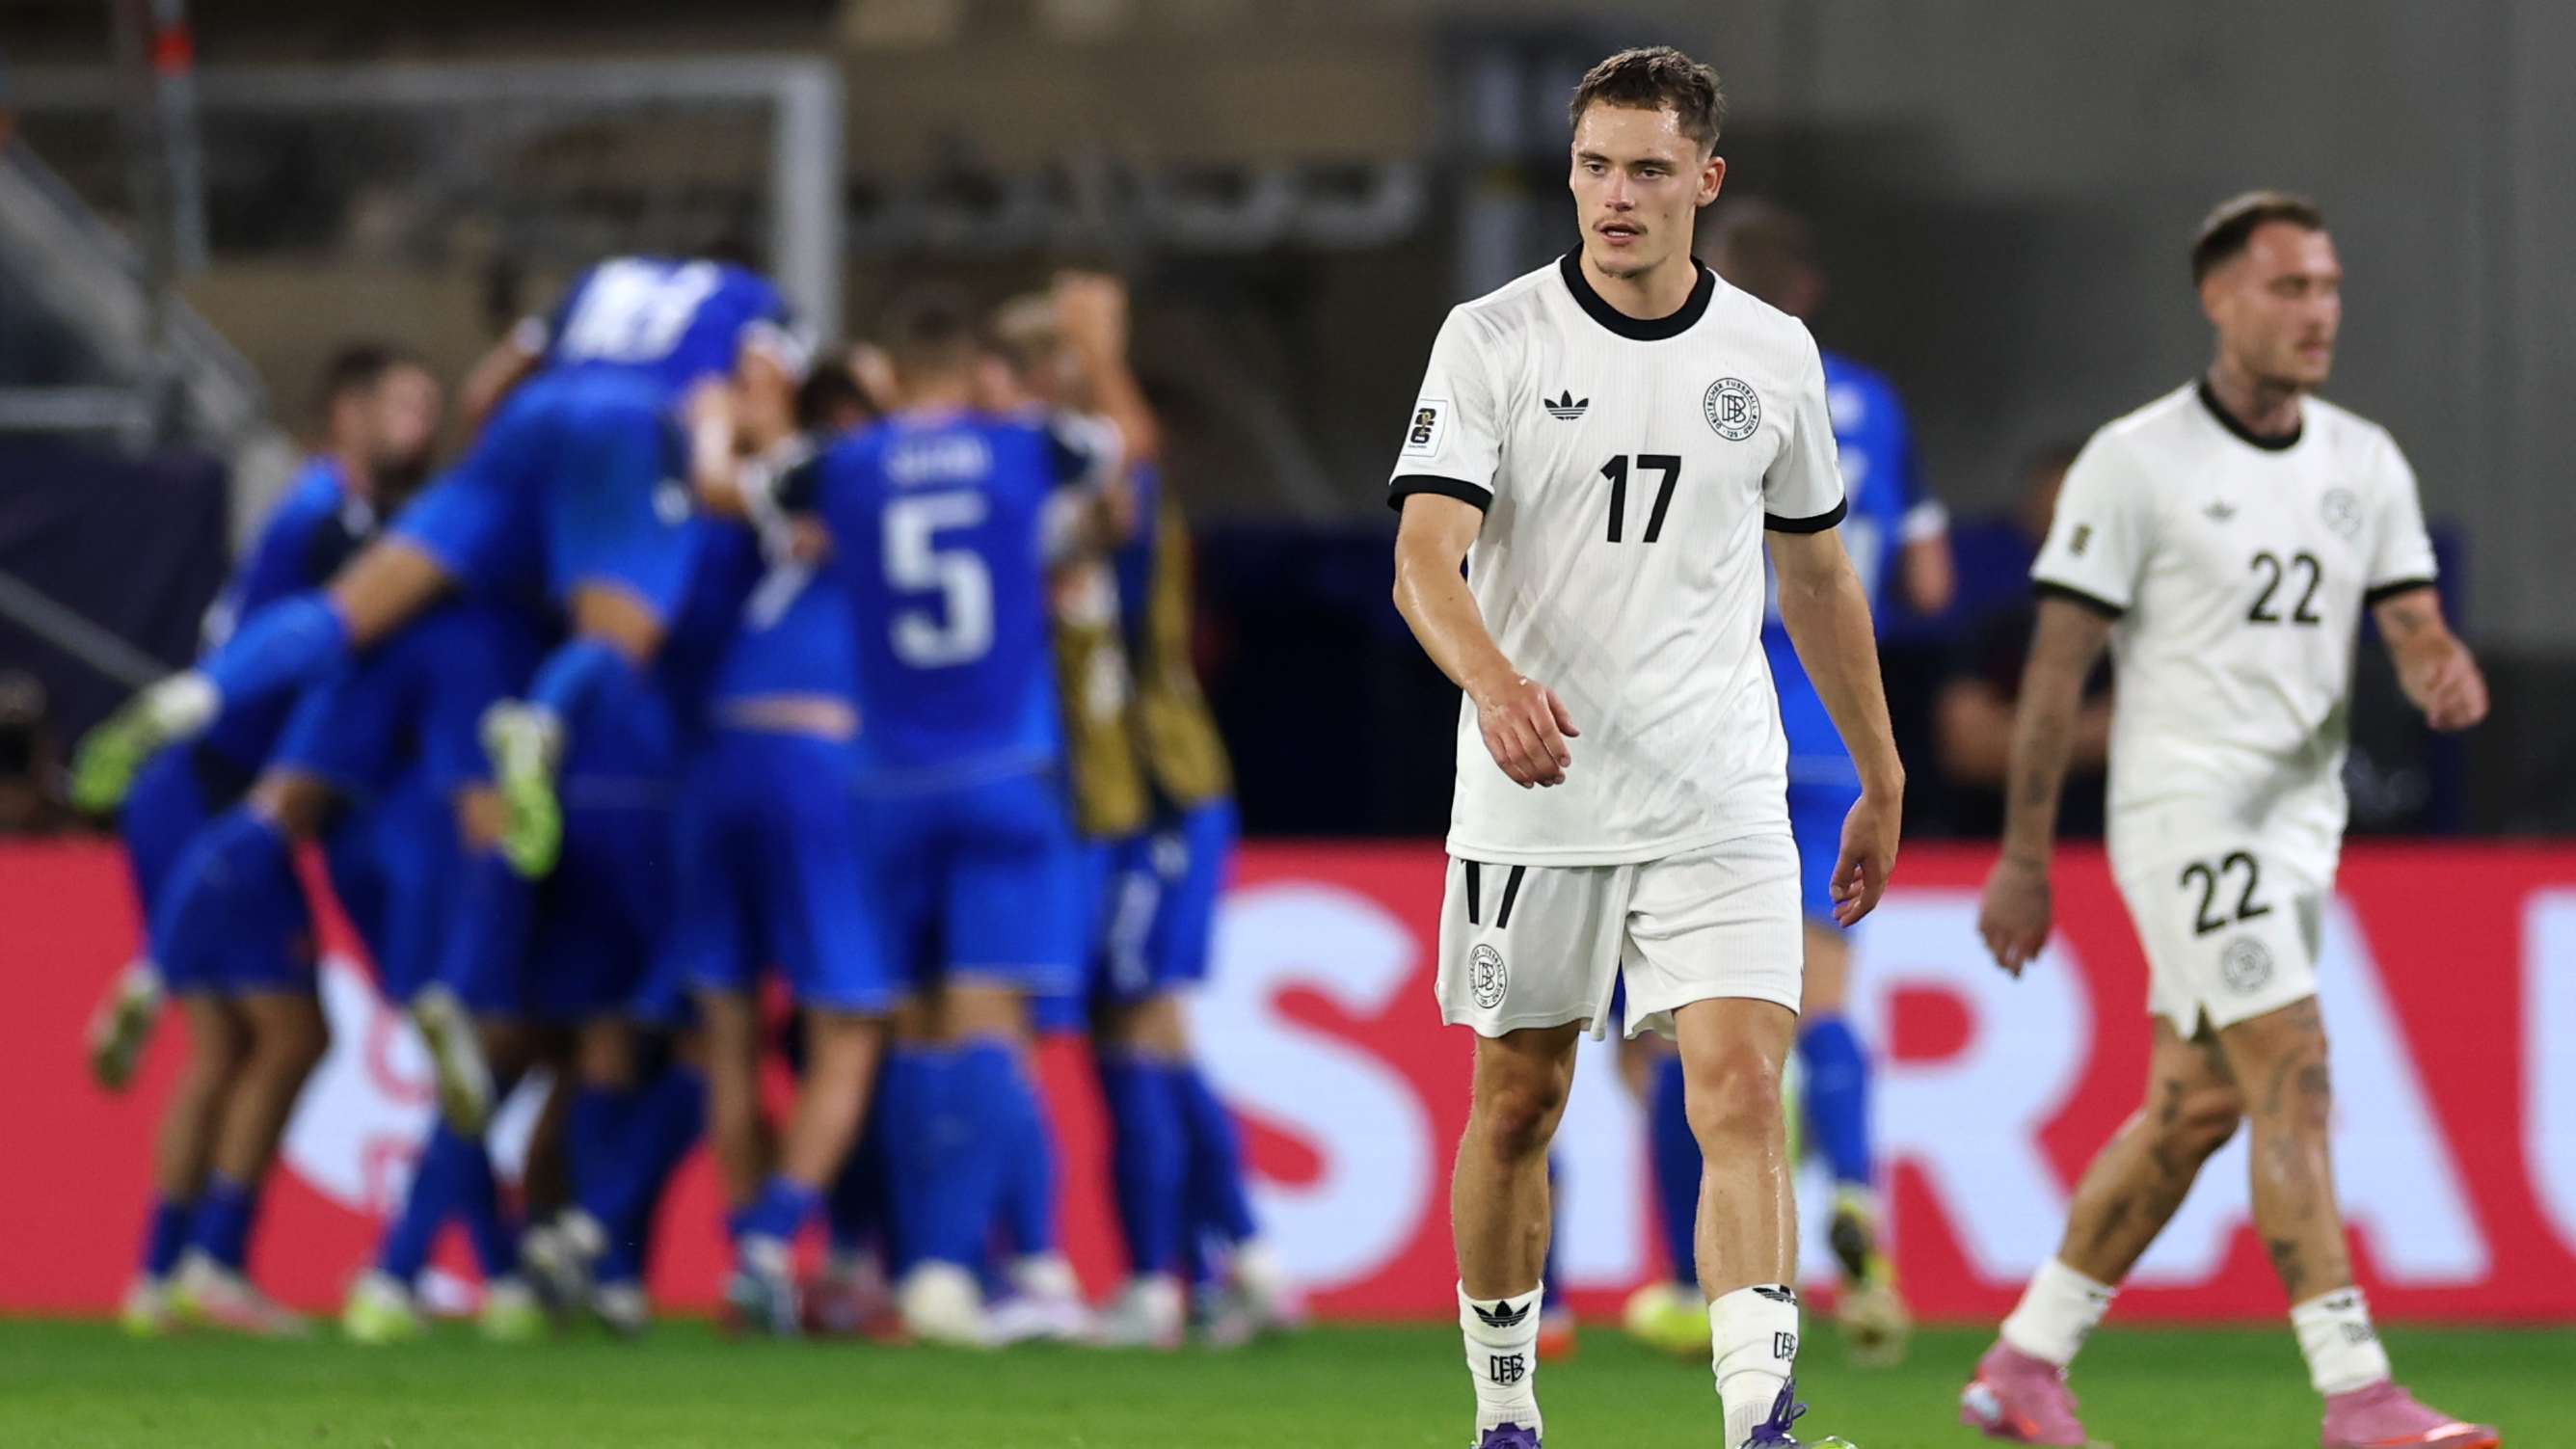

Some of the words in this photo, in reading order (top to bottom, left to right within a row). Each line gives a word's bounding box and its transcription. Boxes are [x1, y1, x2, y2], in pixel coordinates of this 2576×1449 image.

[1599, 454, 1682, 544] 17
[883, 491, 997, 667] 5
[2247, 550, 2322, 624] 22
[2180, 847, 2273, 936] 22
